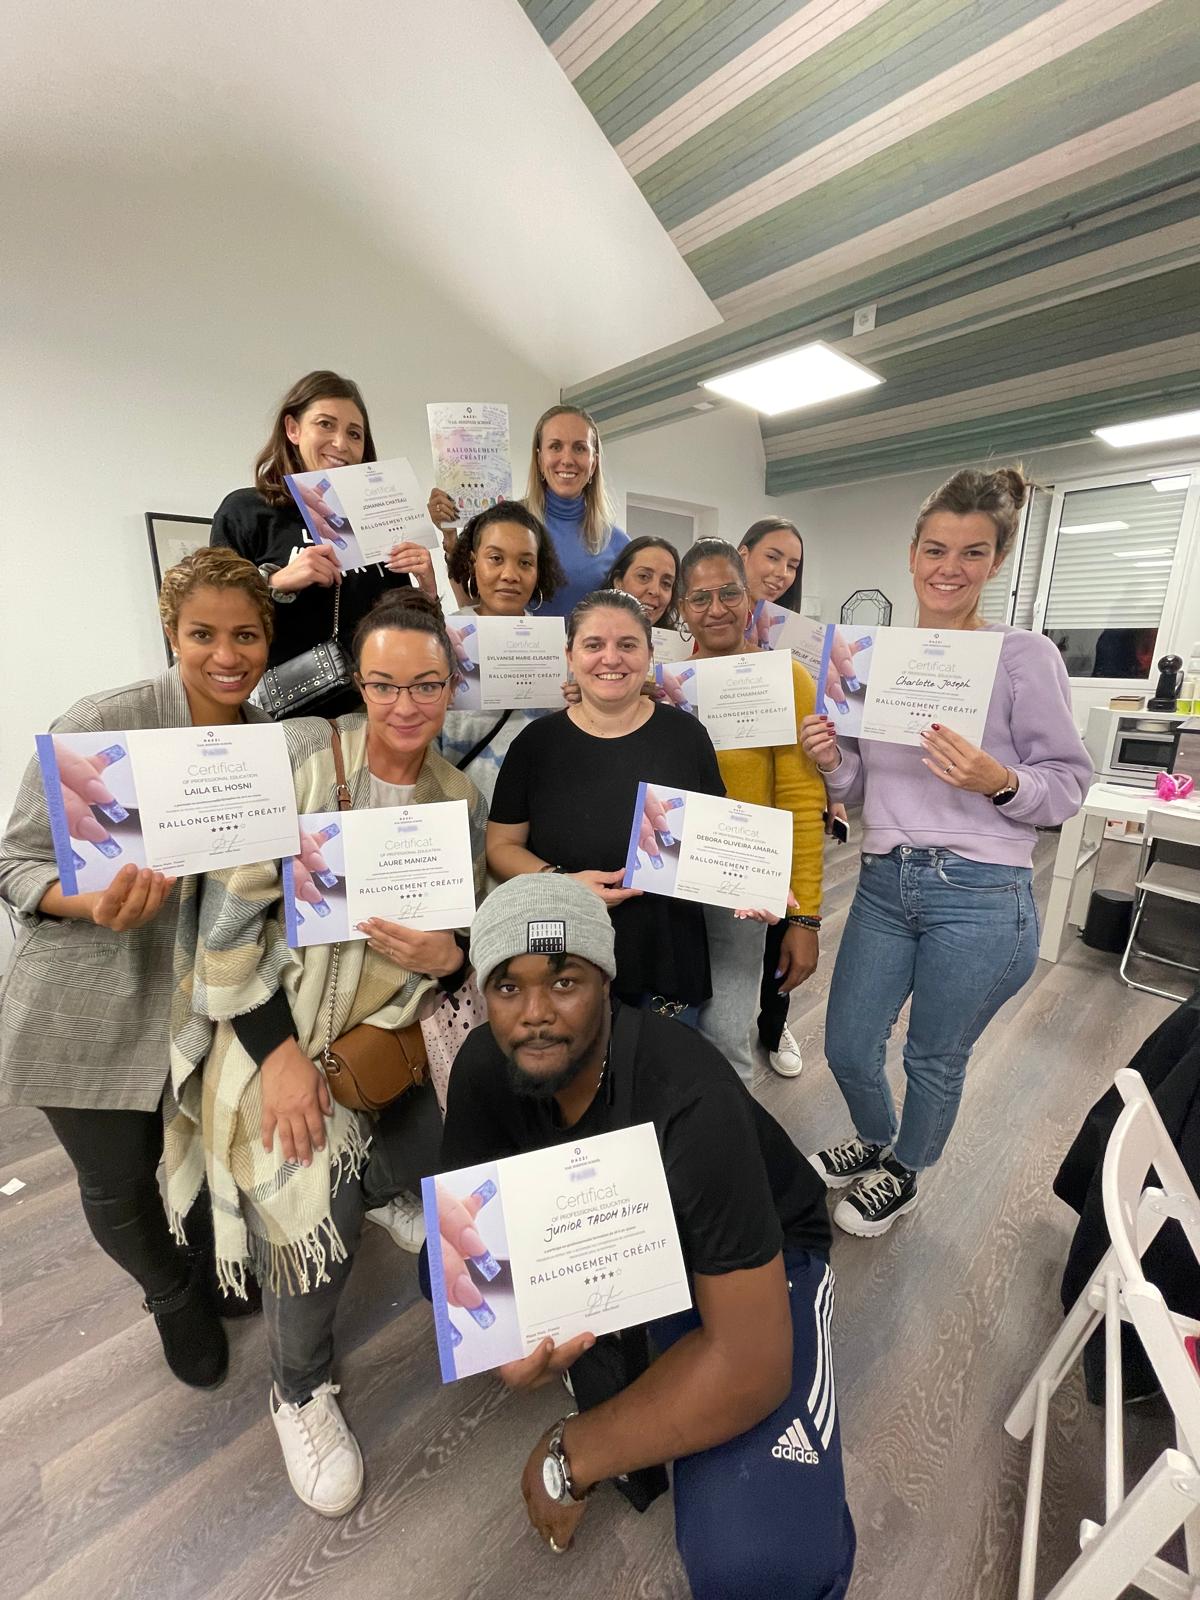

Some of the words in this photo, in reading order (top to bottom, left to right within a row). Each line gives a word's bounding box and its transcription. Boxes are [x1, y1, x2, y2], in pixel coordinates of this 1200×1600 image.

[363, 502, 385, 510] JOHANNA
[361, 518, 403, 530] RALLONGEMENT
[908, 659, 956, 672] Certificat
[895, 675, 935, 687] Charlotte
[937, 679, 971, 690] Joseph
[875, 698, 940, 710] RALLONGEMENT
[942, 704, 978, 715] CRÉATIF
[708, 710, 758, 719] RALLONGEMENT
[187, 761, 247, 776] Certificat
[225, 783, 252, 791] HOSNI
[159, 812, 244, 829] RALLONGEMENT
[718, 822, 760, 838] Certificat
[385, 836, 432, 850] Certificat
[696, 834, 722, 844] DEBORA
[723, 840, 752, 849] OLIVEIRA
[753, 845, 778, 854] AMARAL
[379, 858, 403, 867] LAURE
[404, 856, 437, 865] MANIZAN
[690, 855, 749, 871] RALLONGEMENT
[752, 866, 782, 877] CRÉATIF
[359, 881, 427, 894] RALLONGEMENT
[556, 1184, 618, 1210] Certificat
[560, 1207, 599, 1220] PROFESSIONAL
[600, 1198, 630, 1209] EDUCATION
[530, 1252, 618, 1285] RALLONGEMENT
[622, 1238, 667, 1258] CRÉATIF
[772, 1445, 819, 1464] adidas
